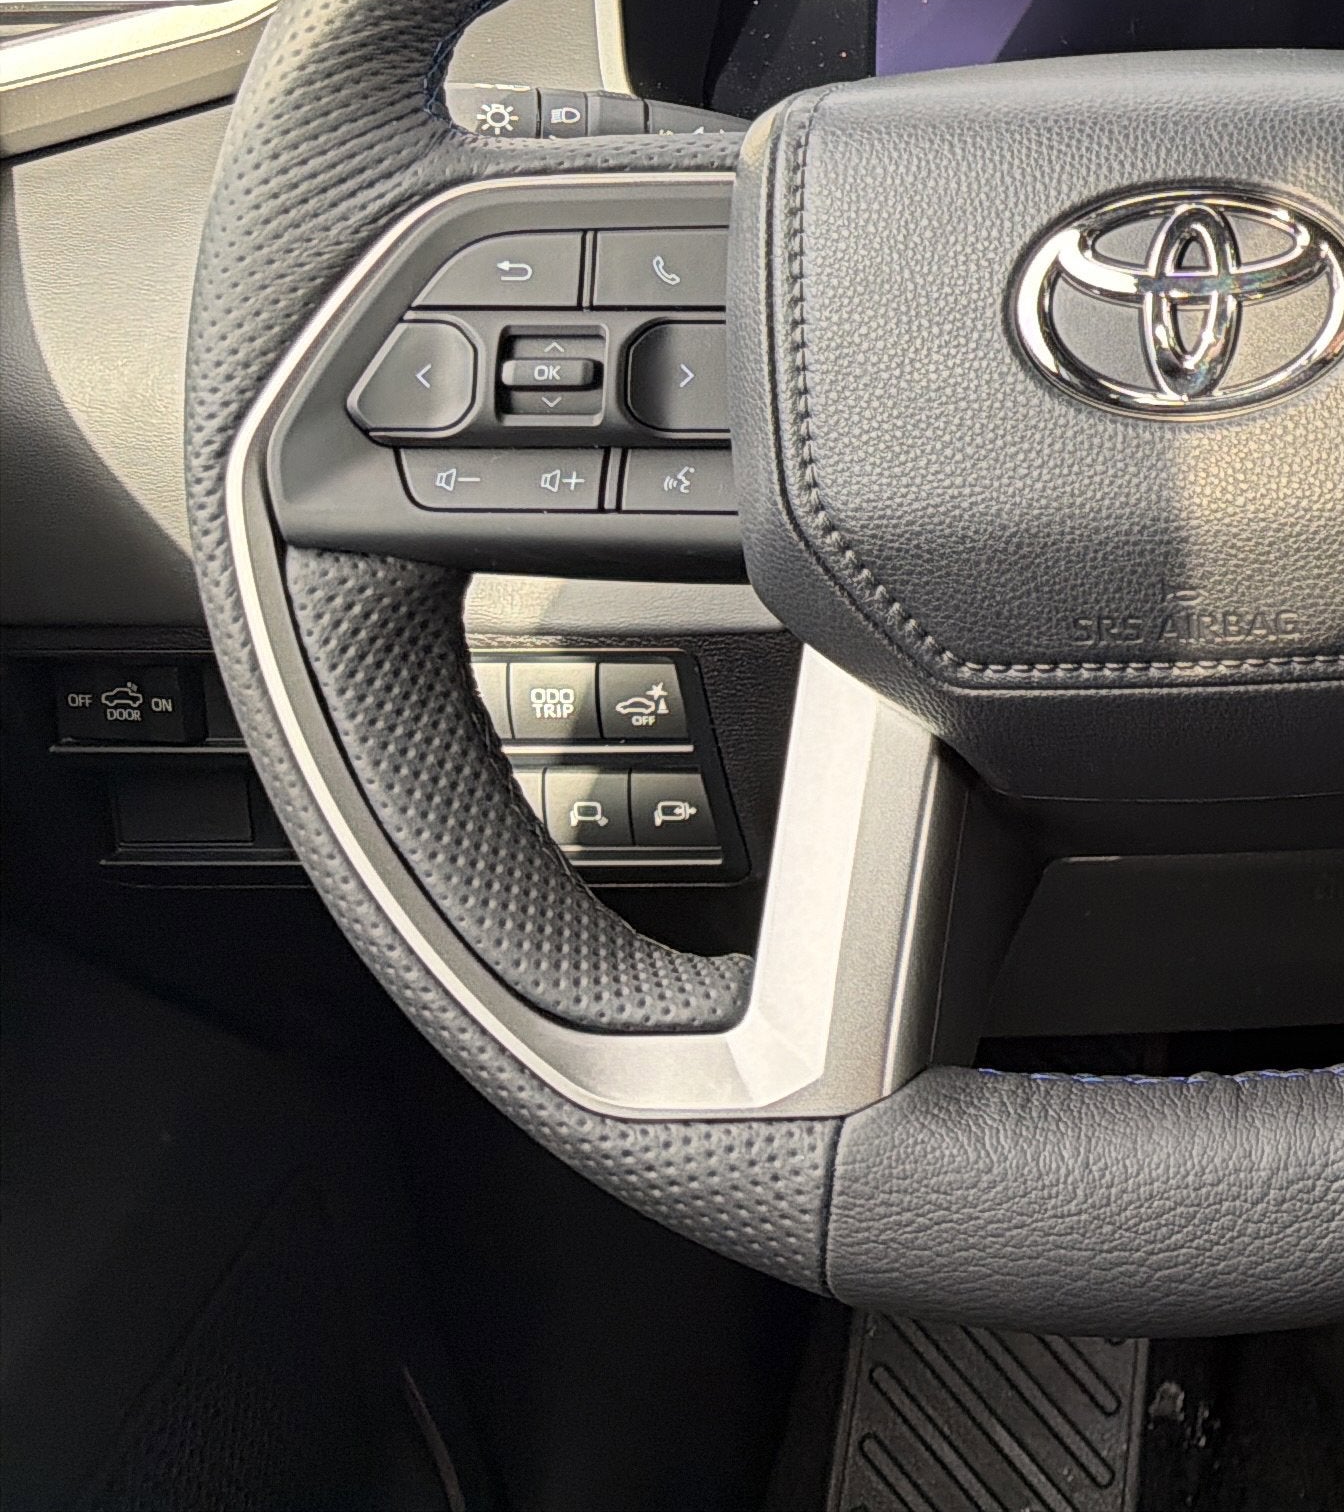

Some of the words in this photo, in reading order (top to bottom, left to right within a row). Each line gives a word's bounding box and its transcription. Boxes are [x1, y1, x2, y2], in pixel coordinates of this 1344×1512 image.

[534, 366, 560, 380] OK
[1073, 618, 1144, 645] SRS
[1159, 610, 1299, 644] AIRBAG
[68, 694, 93, 708] OFF
[152, 698, 173, 712] ON
[530, 688, 574, 704] ODO
[107, 709, 142, 721] DOOR
[532, 704, 574, 718] TRIP
[632, 716, 656, 726] OFF
